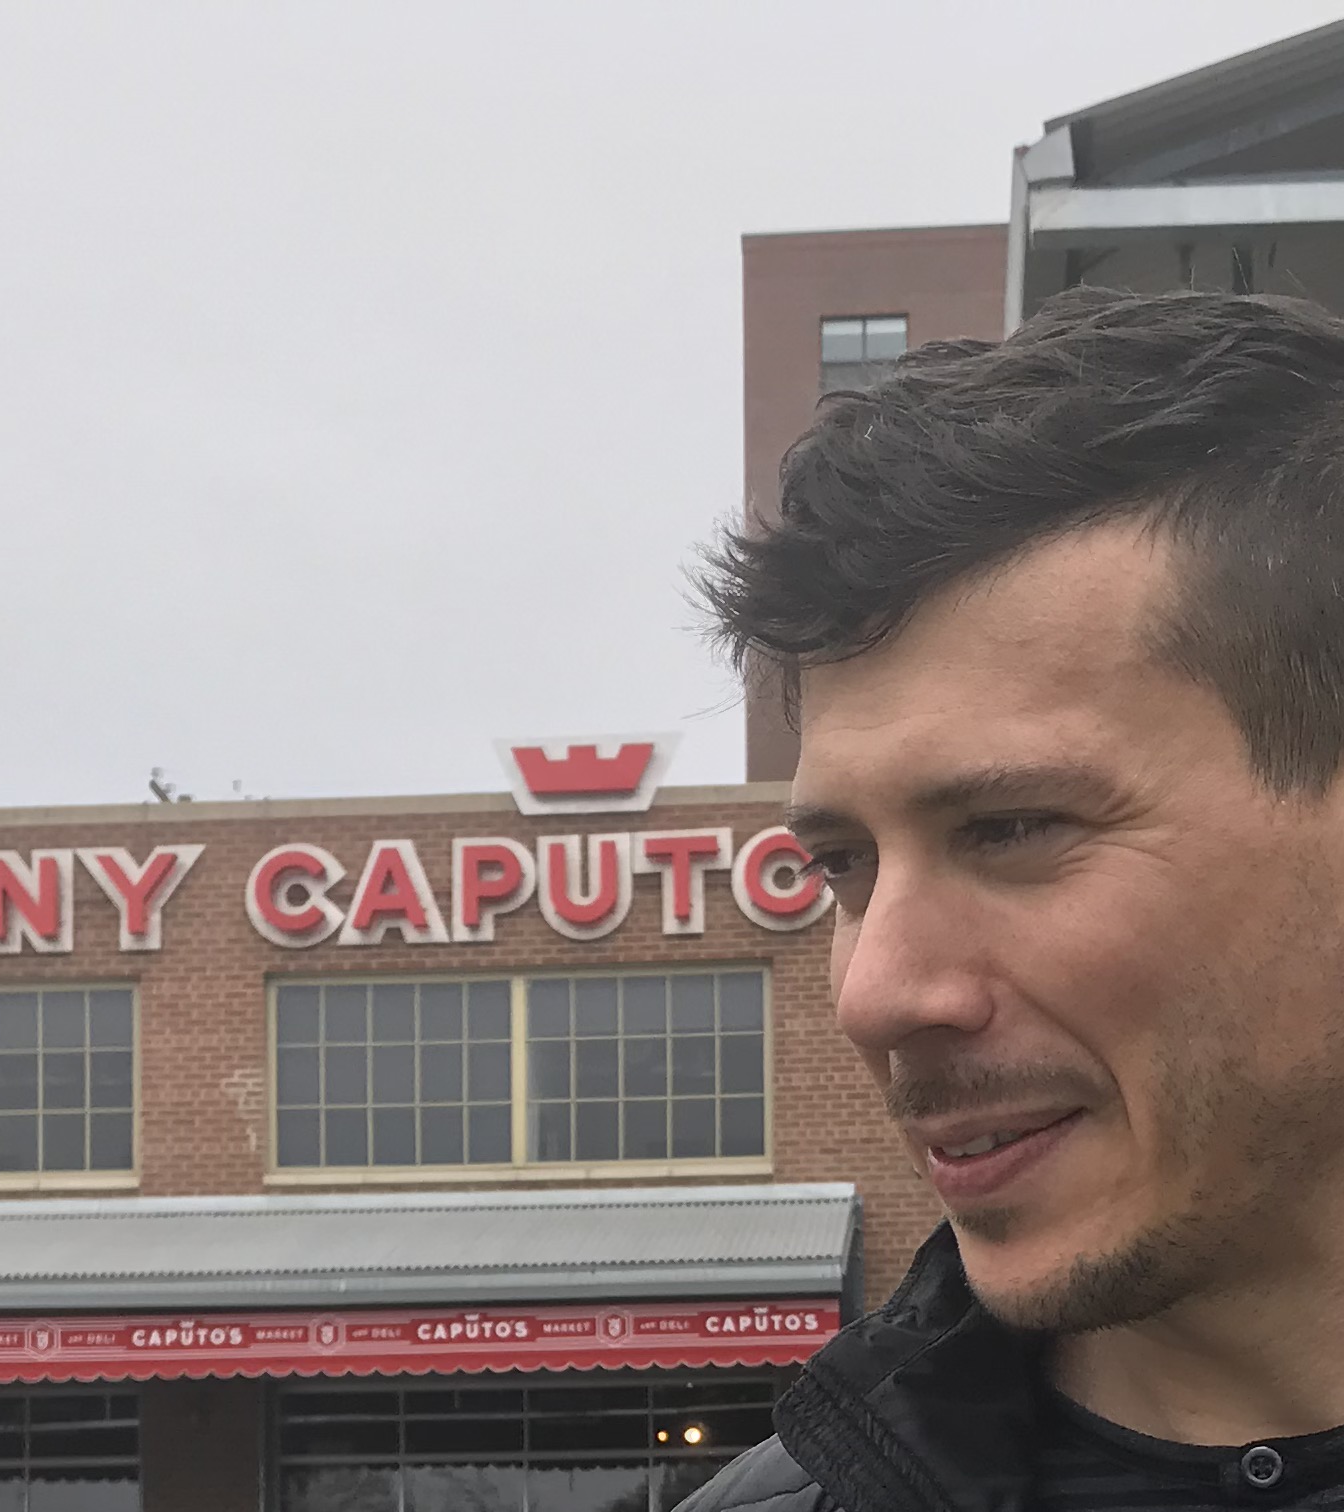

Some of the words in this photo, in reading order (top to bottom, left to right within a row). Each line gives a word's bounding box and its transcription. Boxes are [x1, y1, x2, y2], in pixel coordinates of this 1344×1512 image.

[132, 1326, 243, 1346] CAPUTO'S
[256, 1328, 304, 1339] MARKET
[417, 1320, 529, 1340] CAPUTO'S
[542, 1321, 591, 1333] MARKET
[705, 1312, 819, 1333] CAPUTO'S
